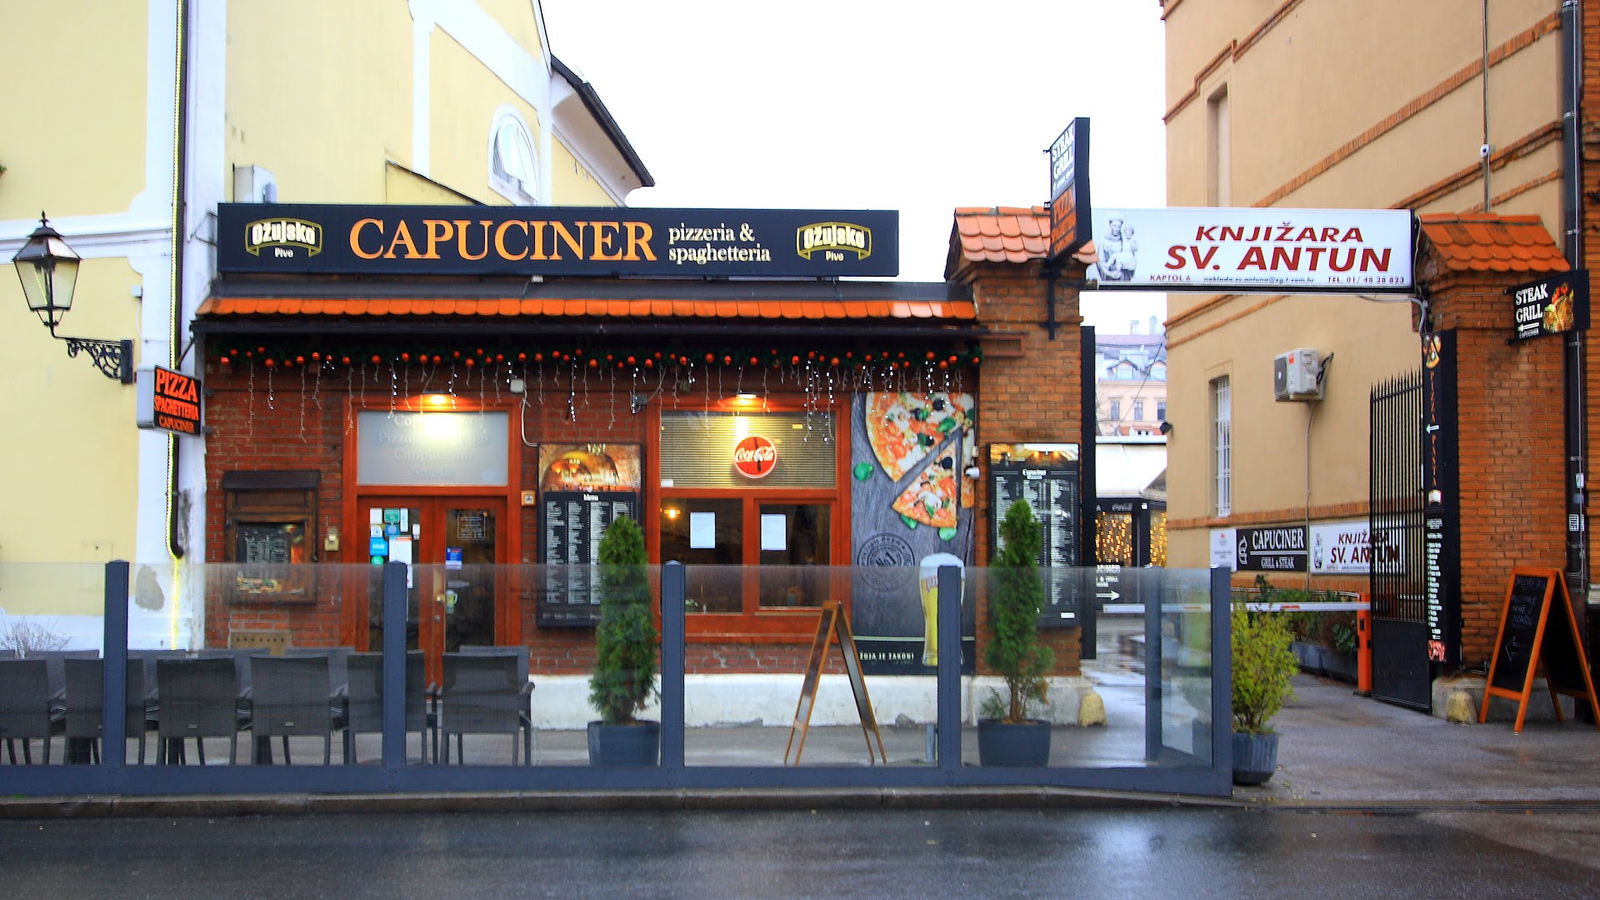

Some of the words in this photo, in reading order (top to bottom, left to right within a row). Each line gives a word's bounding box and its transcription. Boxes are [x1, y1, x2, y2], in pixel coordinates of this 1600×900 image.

[251, 220, 316, 246] Ožujsko
[349, 218, 657, 261] CAPUCINER
[668, 222, 735, 245] pizzeria
[739, 222, 755, 242] &
[803, 224, 866, 250] Ožujsko
[1195, 221, 1364, 243] KNJIŽARA
[274, 247, 294, 259] Pivo
[668, 243, 771, 265] spaghetteria
[825, 251, 844, 263] Pivo
[1165, 245, 1220, 270] SV.
[1238, 247, 1392, 272] ANTUN
[1516, 283, 1548, 305] STEAK
[1516, 303, 1543, 323] GRILL
[155, 367, 198, 403] PIZZA
[1252, 528, 1304, 549] CAPUCINER
[1330, 547, 1346, 563] SV.
